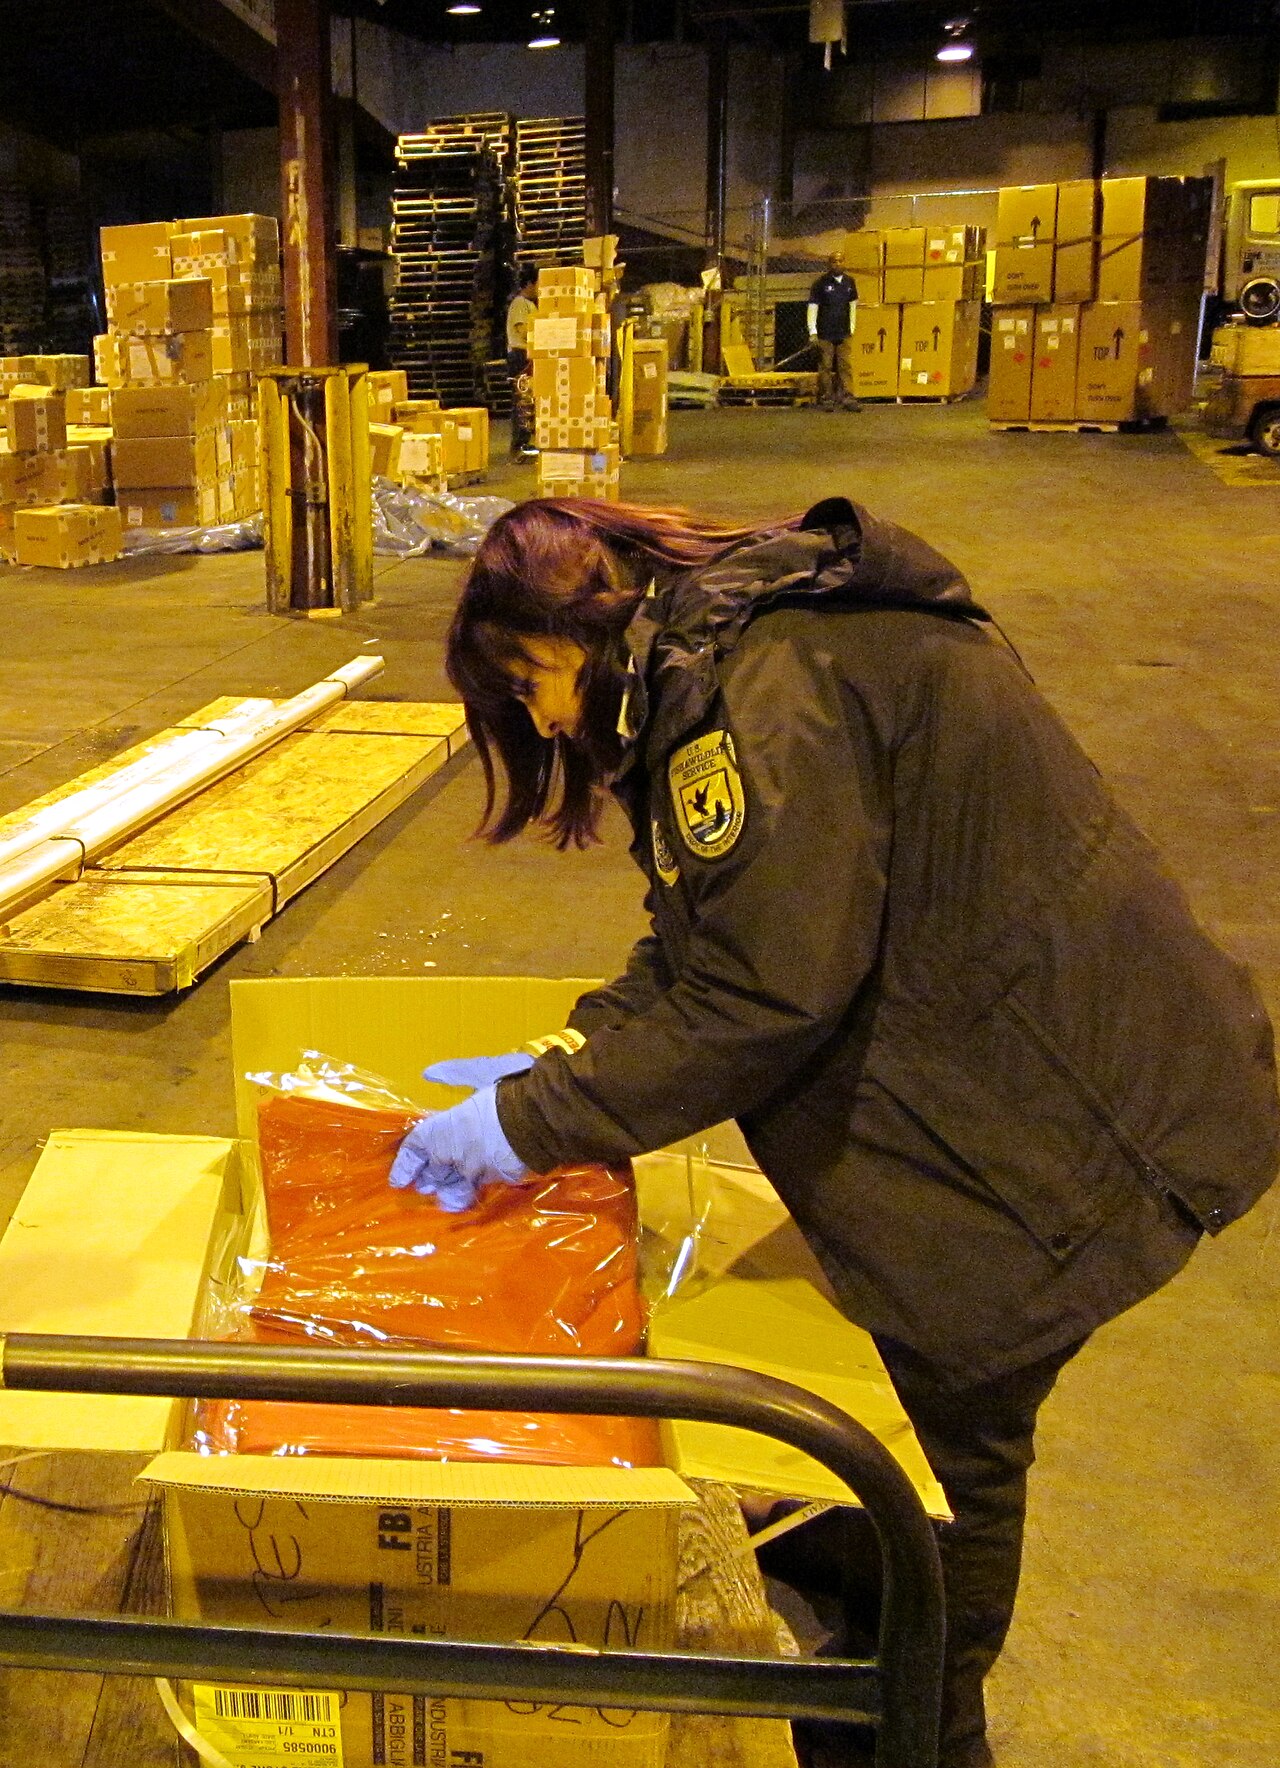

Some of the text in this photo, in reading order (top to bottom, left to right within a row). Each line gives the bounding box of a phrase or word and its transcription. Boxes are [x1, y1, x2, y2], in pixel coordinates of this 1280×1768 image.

[862, 343, 875, 354] TOP
[915, 340, 928, 352] TOP
[1093, 346, 1109, 360] TOP
[683, 759, 717, 780] SERVICE
[723, 810, 743, 847] INTERIOR
[278, 1726, 336, 1738] CTN 1/1
[283, 1742, 337, 1754] 9000585
